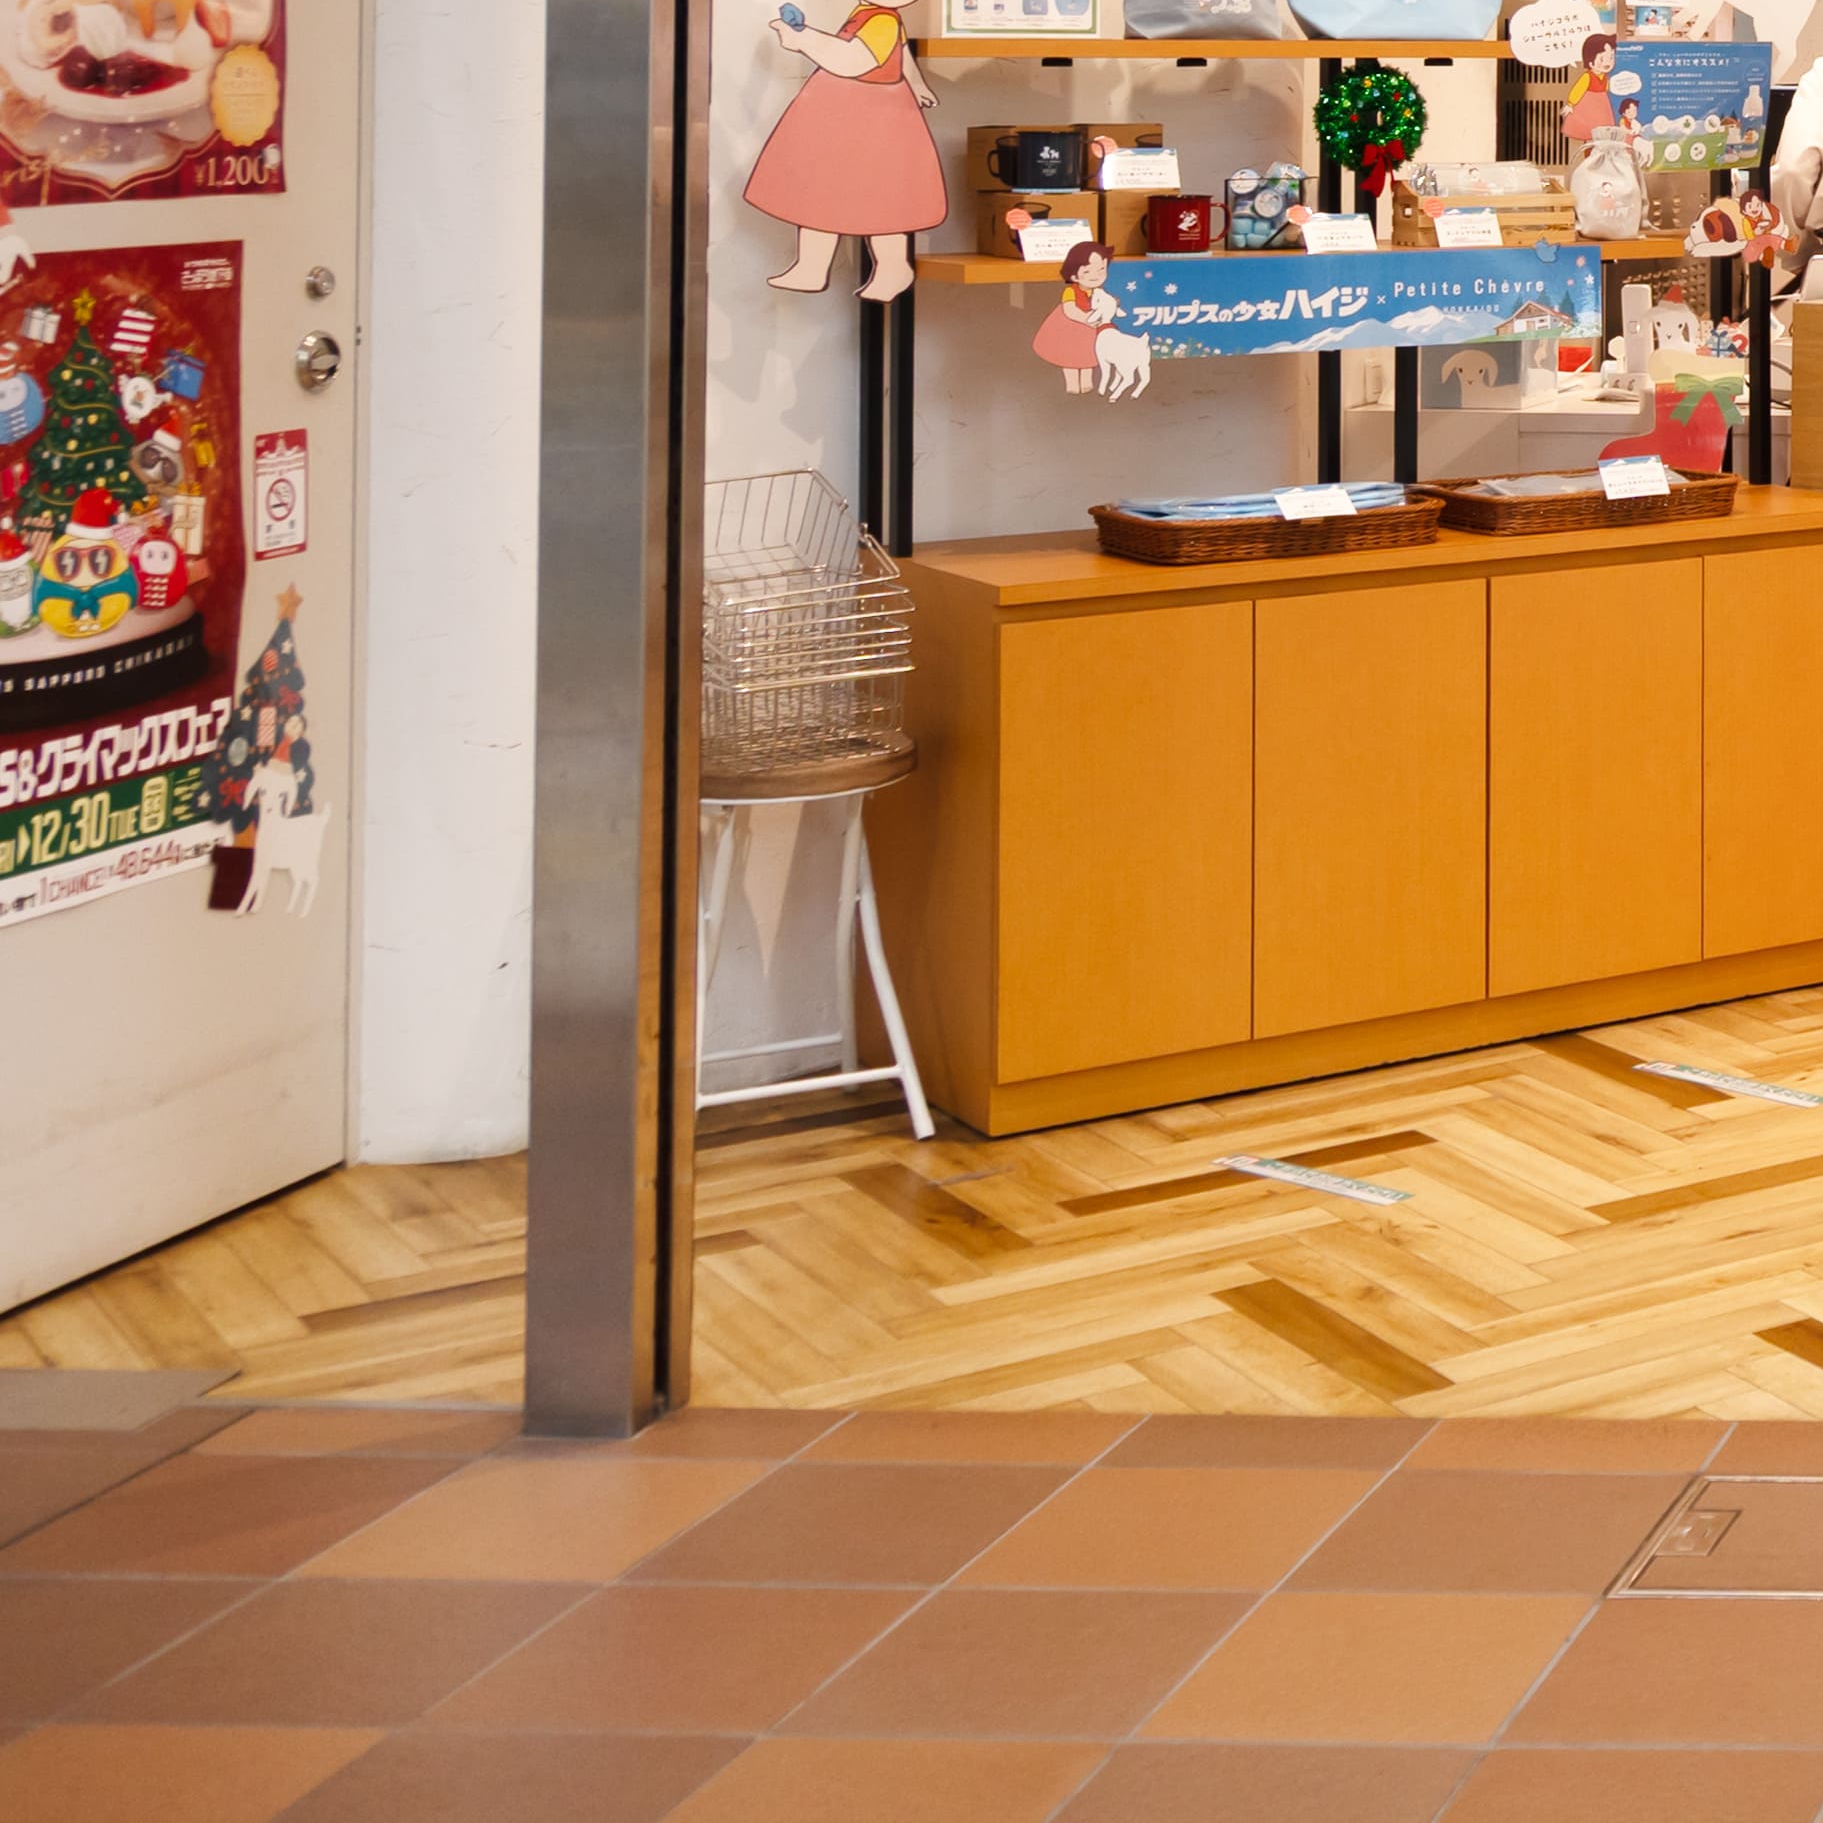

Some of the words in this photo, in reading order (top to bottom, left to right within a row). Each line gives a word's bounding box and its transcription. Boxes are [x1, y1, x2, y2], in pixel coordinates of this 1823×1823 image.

[1132, 286, 1370, 327] アルプスの少女ハイジ
[1393, 280, 1461, 298] Petite
[1473, 277, 1545, 295] Chèvre
